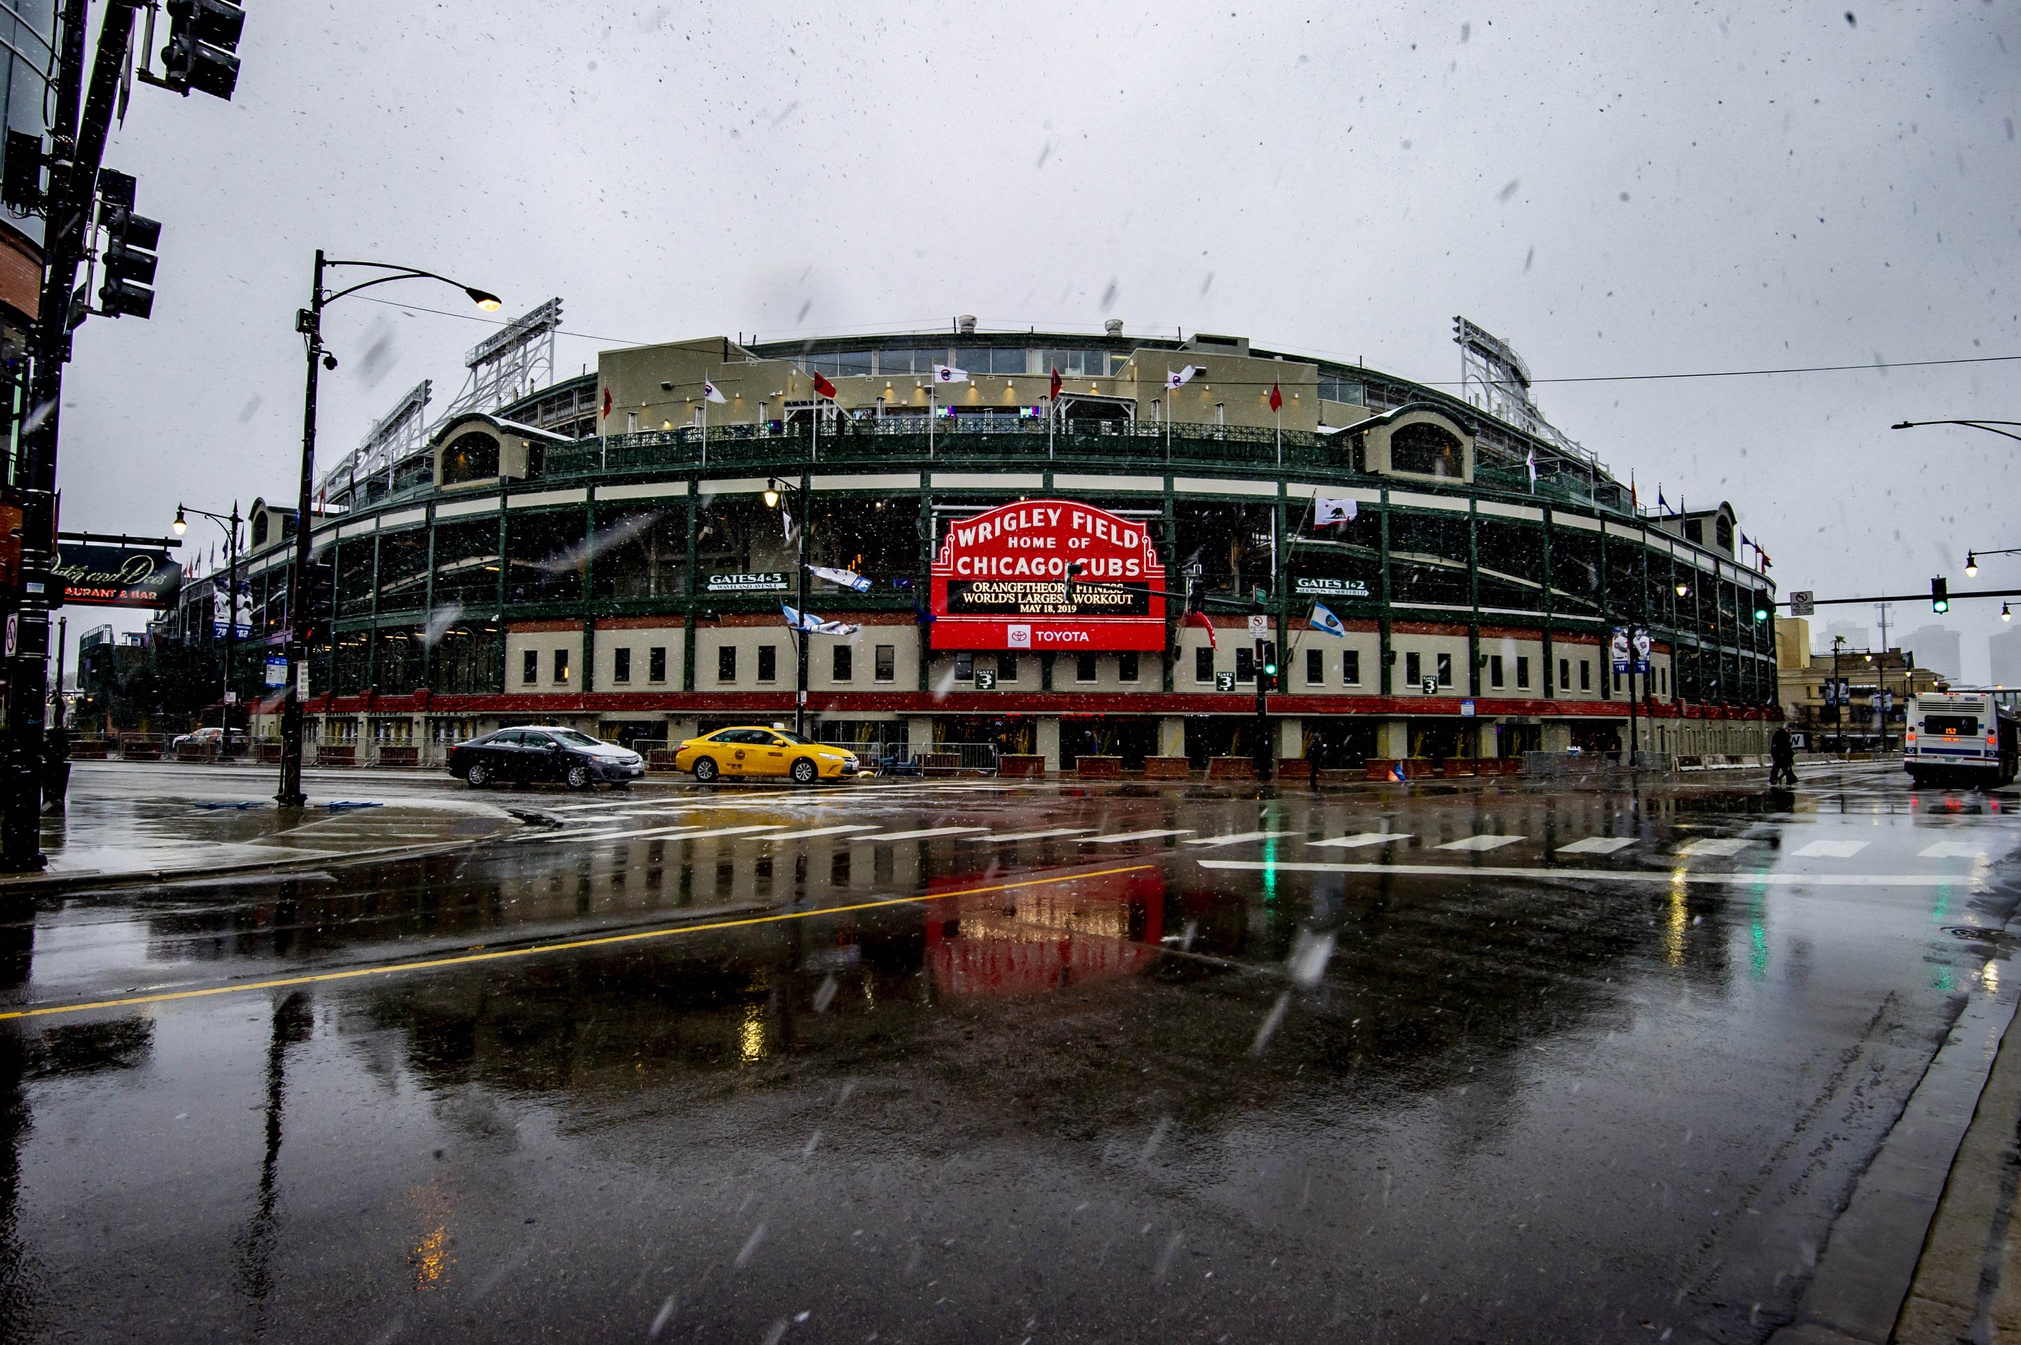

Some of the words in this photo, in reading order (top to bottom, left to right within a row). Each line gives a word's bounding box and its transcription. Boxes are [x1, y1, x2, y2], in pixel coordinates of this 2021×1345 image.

[957, 507, 1062, 548] WRIGLEY
[1072, 510, 1139, 549] FIELD
[1008, 536, 1056, 549] HOME
[1068, 537, 1091, 549] OF
[957, 556, 1062, 577] CHICAGO
[1074, 557, 1140, 577] CUBS
[709, 573, 757, 584] GATES
[1297, 578, 1342, 589] GATES
[972, 582, 1065, 594] ORANGETHEOR
[119, 589, 128, 599] &
[130, 589, 158, 600] BAR
[963, 592, 1016, 604] WORLD'S
[1072, 594, 1133, 605] WORKOUT
[1020, 604, 1040, 613] MAY
[1043, 604, 1055, 614] 18,
[1057, 604, 1077, 613] 2019
[1035, 631, 1090, 642] TOYOTA
[979, 674, 992, 686] 3
[1219, 677, 1232, 688] 3
[1425, 680, 1435, 691] 3
[1945, 727, 1957, 735] 152
